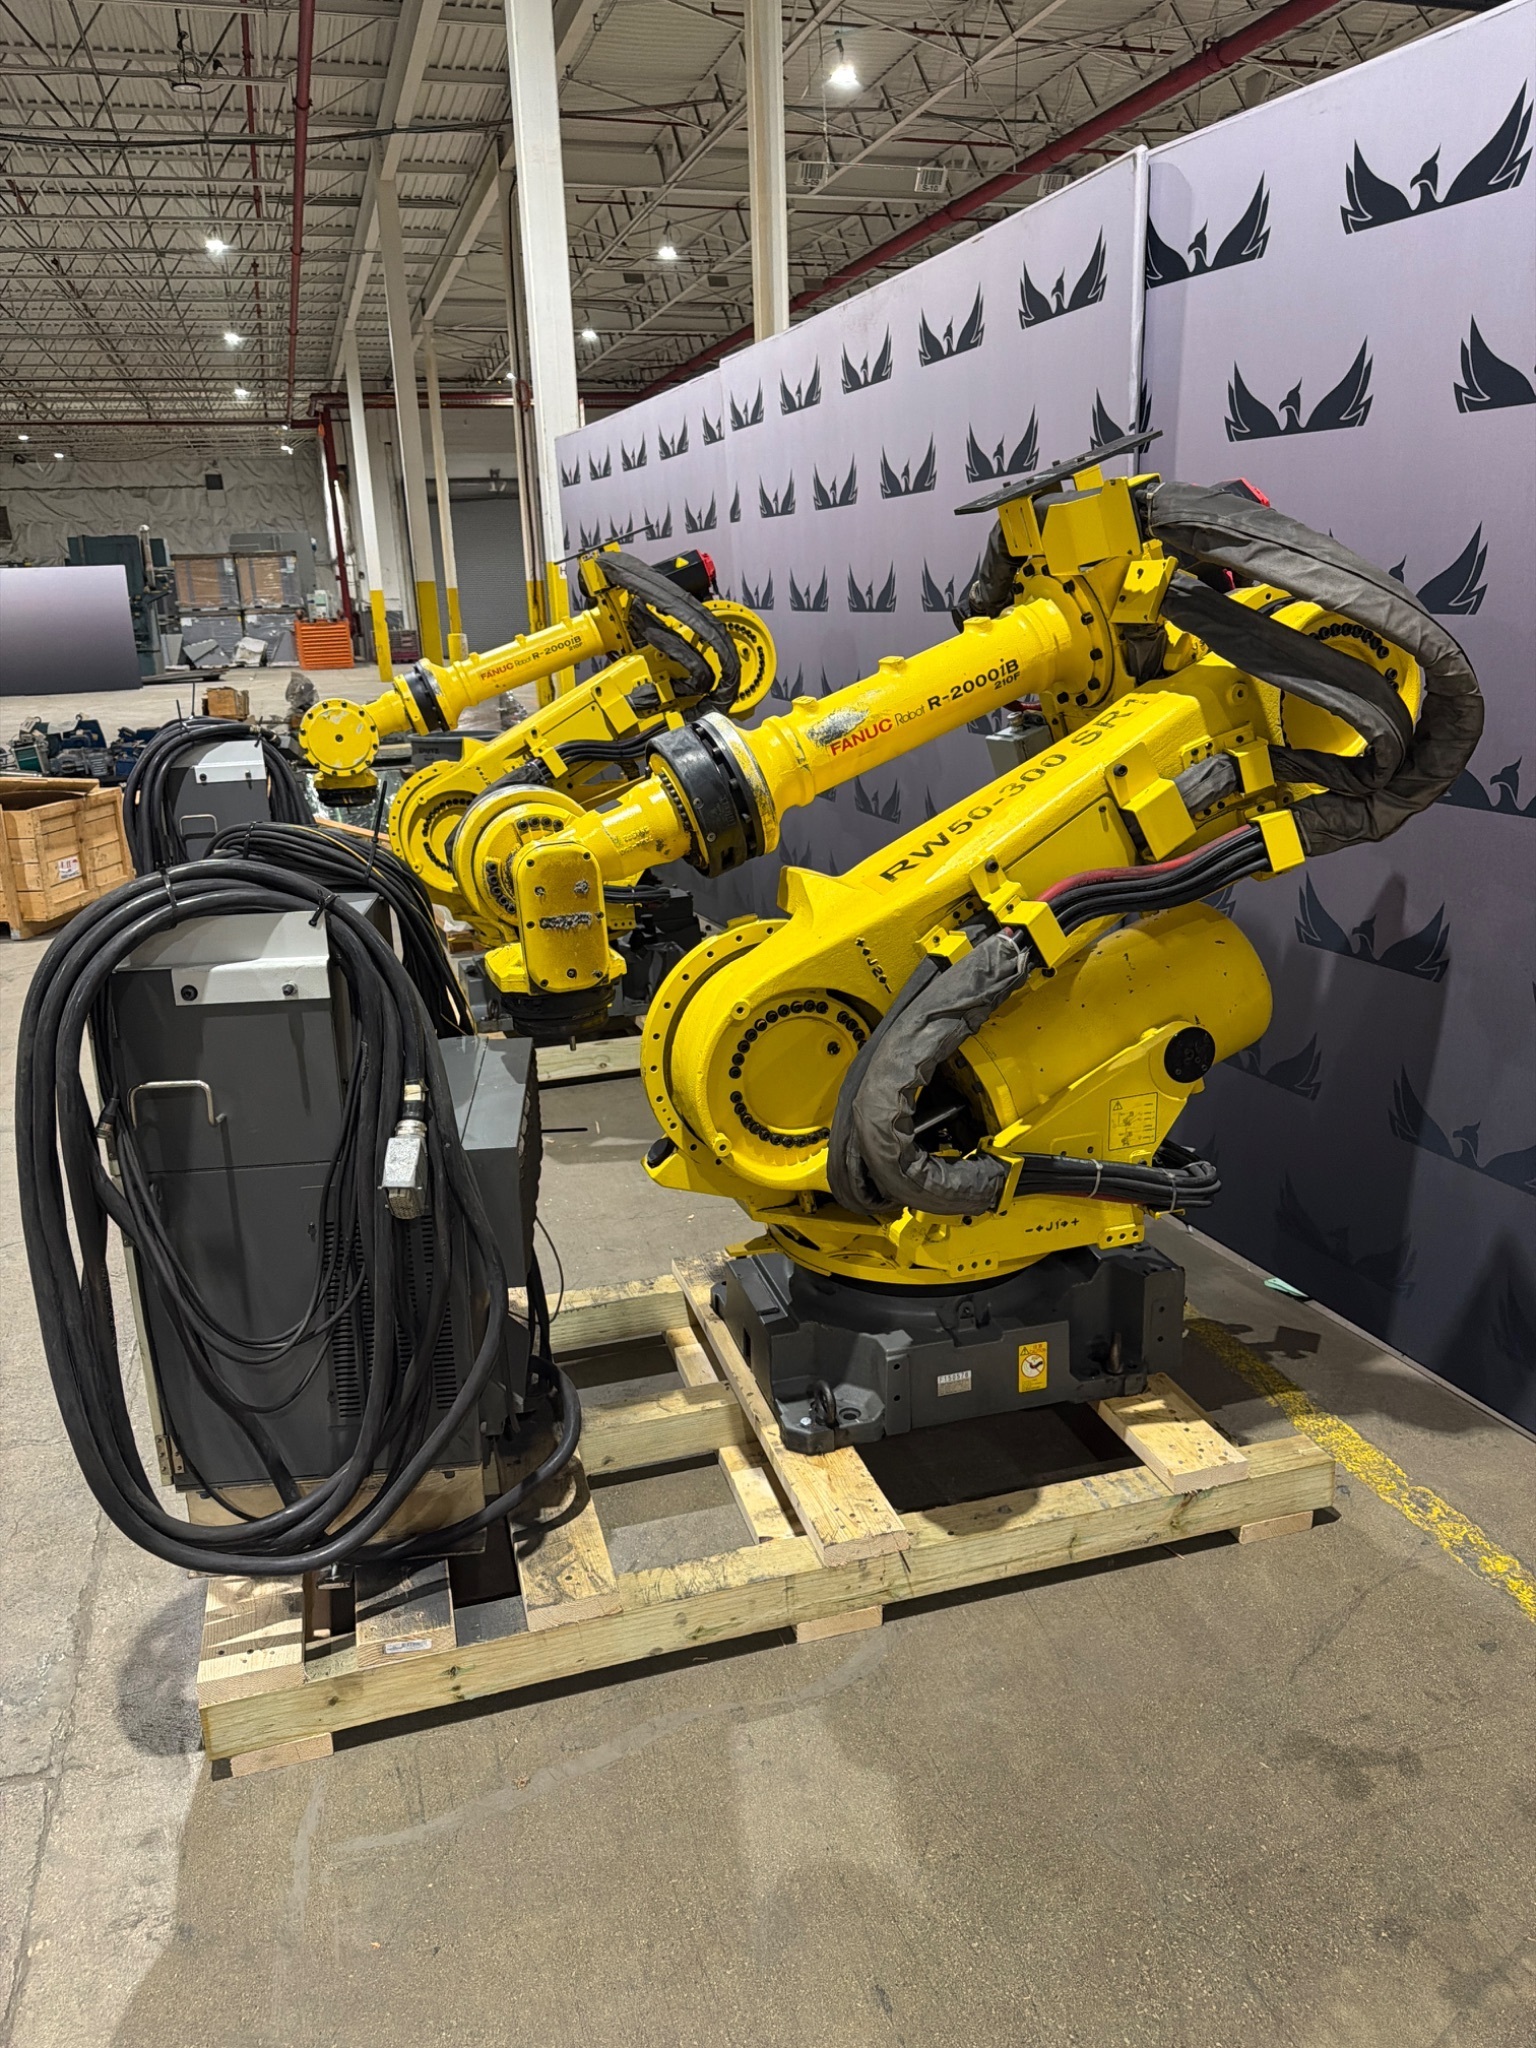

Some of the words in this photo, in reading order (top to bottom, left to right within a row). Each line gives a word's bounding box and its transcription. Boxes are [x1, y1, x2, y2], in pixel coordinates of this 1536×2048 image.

[480, 662, 514, 680] FANUC
[532, 635, 582, 660] R-2000iB
[994, 672, 1021, 690] 210F
[830, 718, 893, 756] FANUC
[894, 706, 926, 727] Robot
[927, 658, 1019, 711] R-2000iB
[879, 753, 1067, 883] RW50-300
